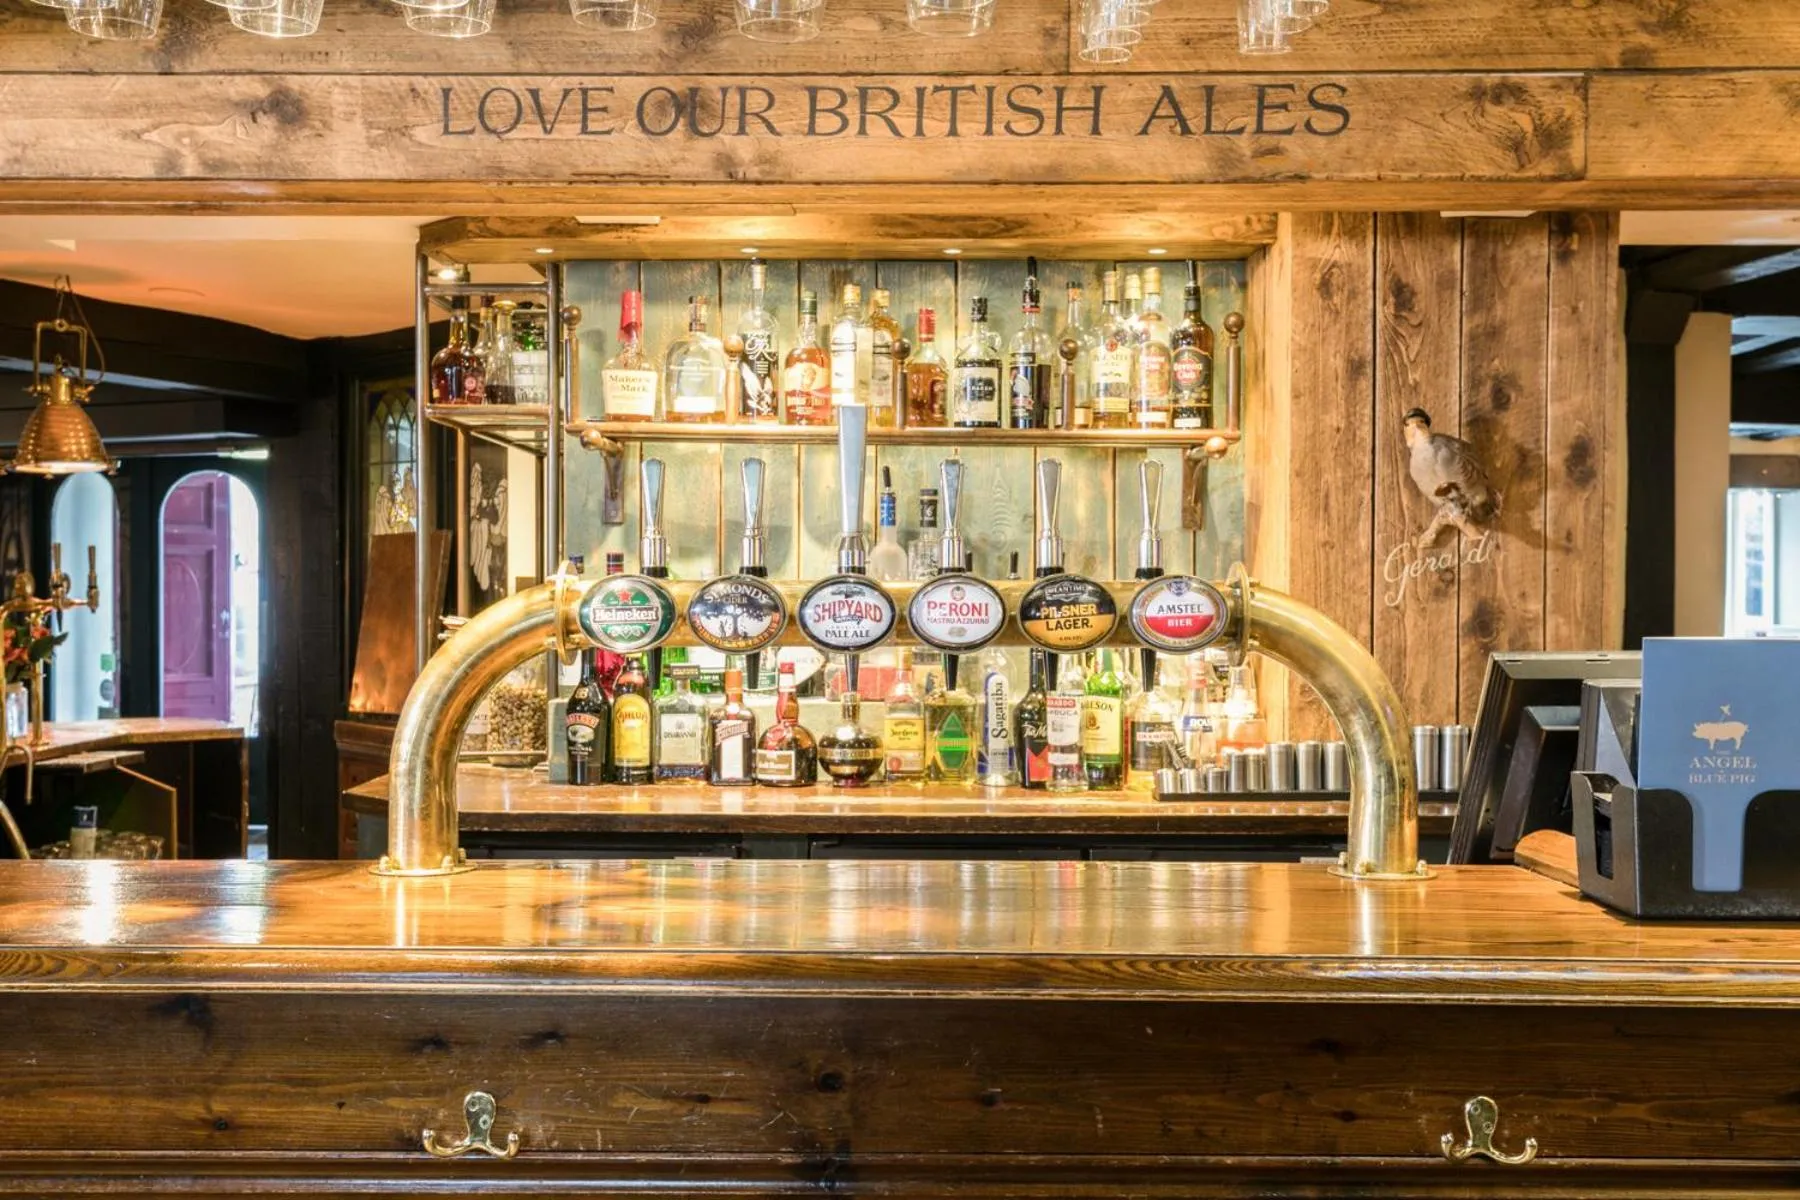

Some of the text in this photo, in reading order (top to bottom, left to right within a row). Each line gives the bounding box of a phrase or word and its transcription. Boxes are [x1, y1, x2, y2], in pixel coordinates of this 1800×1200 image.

[440, 82, 1351, 139] LOVE OUR BRITISH ALES
[1383, 529, 1492, 607] Gerald
[593, 606, 658, 622] Heineken
[812, 599, 884, 624] SHIPYARD
[926, 601, 990, 617] PERONI
[1040, 603, 1098, 619] PILSNER
[1156, 603, 1205, 615] AMSTEL
[1167, 618, 1193, 628] BIER
[824, 629, 871, 638] PALE ALE
[1688, 756, 1758, 769] ANGEL
[1730, 773, 1757, 784] PIG
